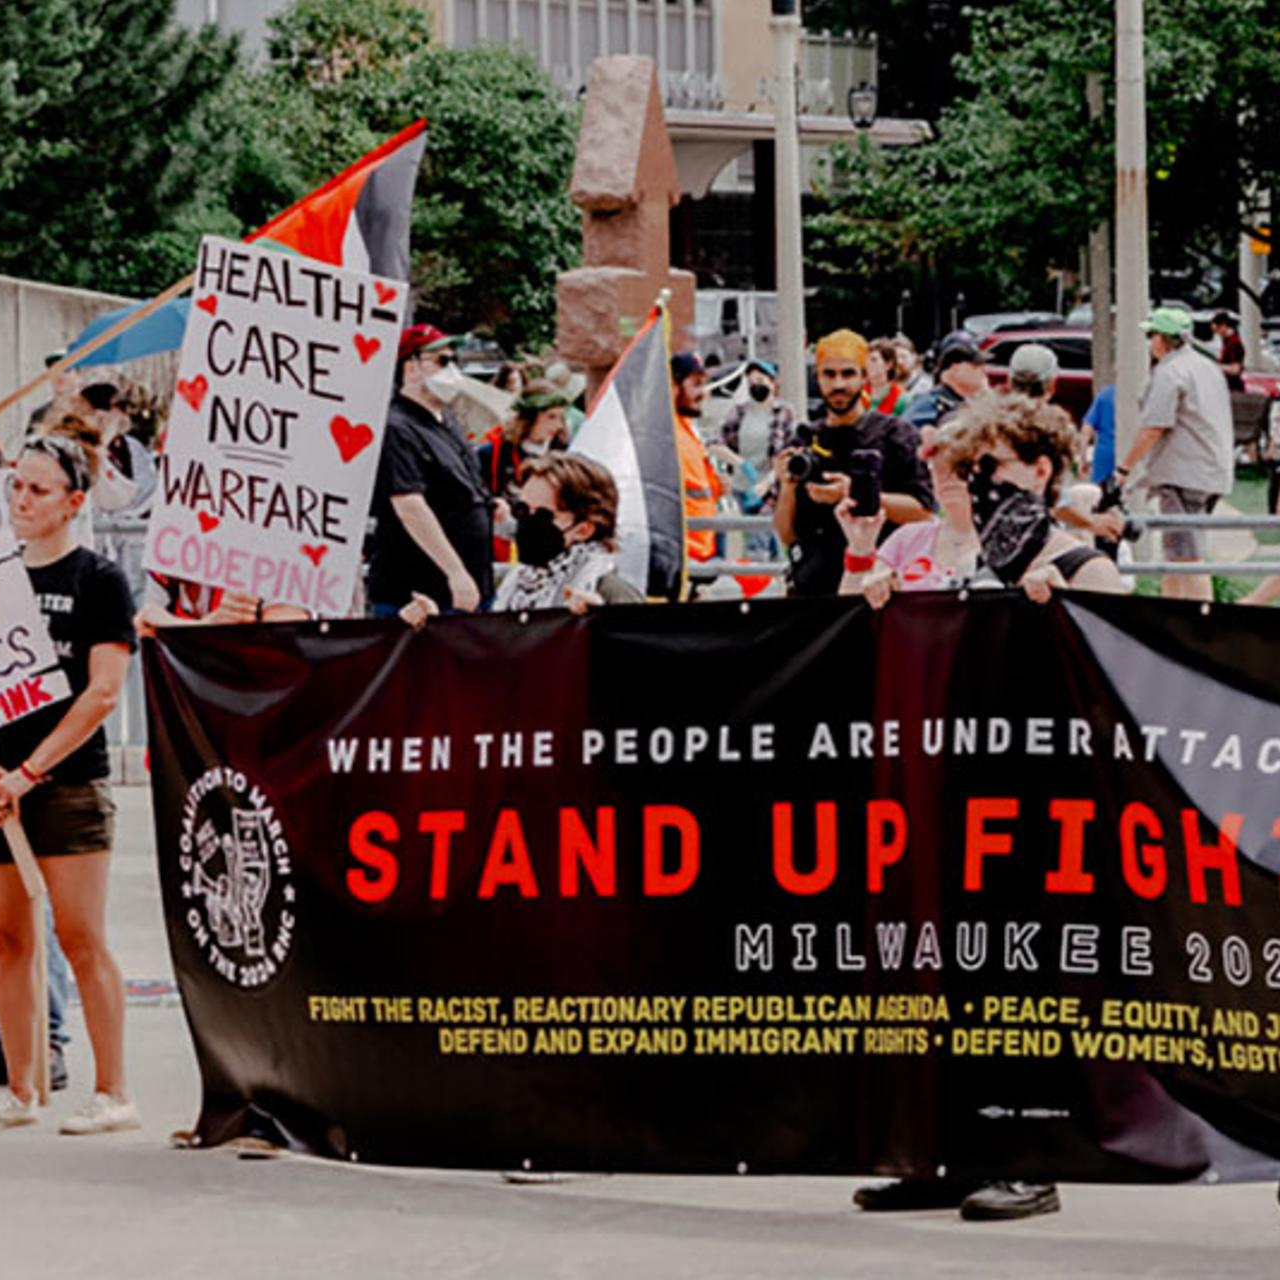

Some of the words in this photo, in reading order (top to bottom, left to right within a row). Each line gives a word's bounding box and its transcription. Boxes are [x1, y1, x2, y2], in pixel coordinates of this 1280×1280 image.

[206, 319, 345, 403] CARE
[208, 394, 299, 451] NOT
[153, 453, 350, 545] WARFARE
[152, 525, 342, 612] CODEPINK
[327, 735, 452, 773] WHEN
[474, 730, 554, 769] THE
[581, 723, 776, 765] PEOPLE
[807, 721, 901, 759] ARE
[921, 717, 1094, 756] UNDER
[345, 802, 701, 904] STAND
[771, 799, 910, 896] UP
[735, 921, 1155, 976] MILWAUKEE
[308, 996, 367, 1021] FIGHT
[372, 996, 414, 1022] THE
[418, 996, 508, 1025] RACIST,
[513, 996, 687, 1022] REACTIONARY
[692, 995, 872, 1022] REPUBLICAN
[875, 995, 951, 1021] AGENDA
[983, 996, 1091, 1028] PEACE,
[1101, 998, 1208, 1037] EQUITY,
[1212, 1008, 1260, 1039] AND
[439, 1027, 529, 1055] DEFEND
[533, 1027, 583, 1054] AND
[588, 1028, 688, 1055] EXPAND
[694, 1027, 858, 1055] IMMIGRANT
[864, 1027, 929, 1054] RIGHTS
[951, 1028, 1062, 1058] DEFEND
